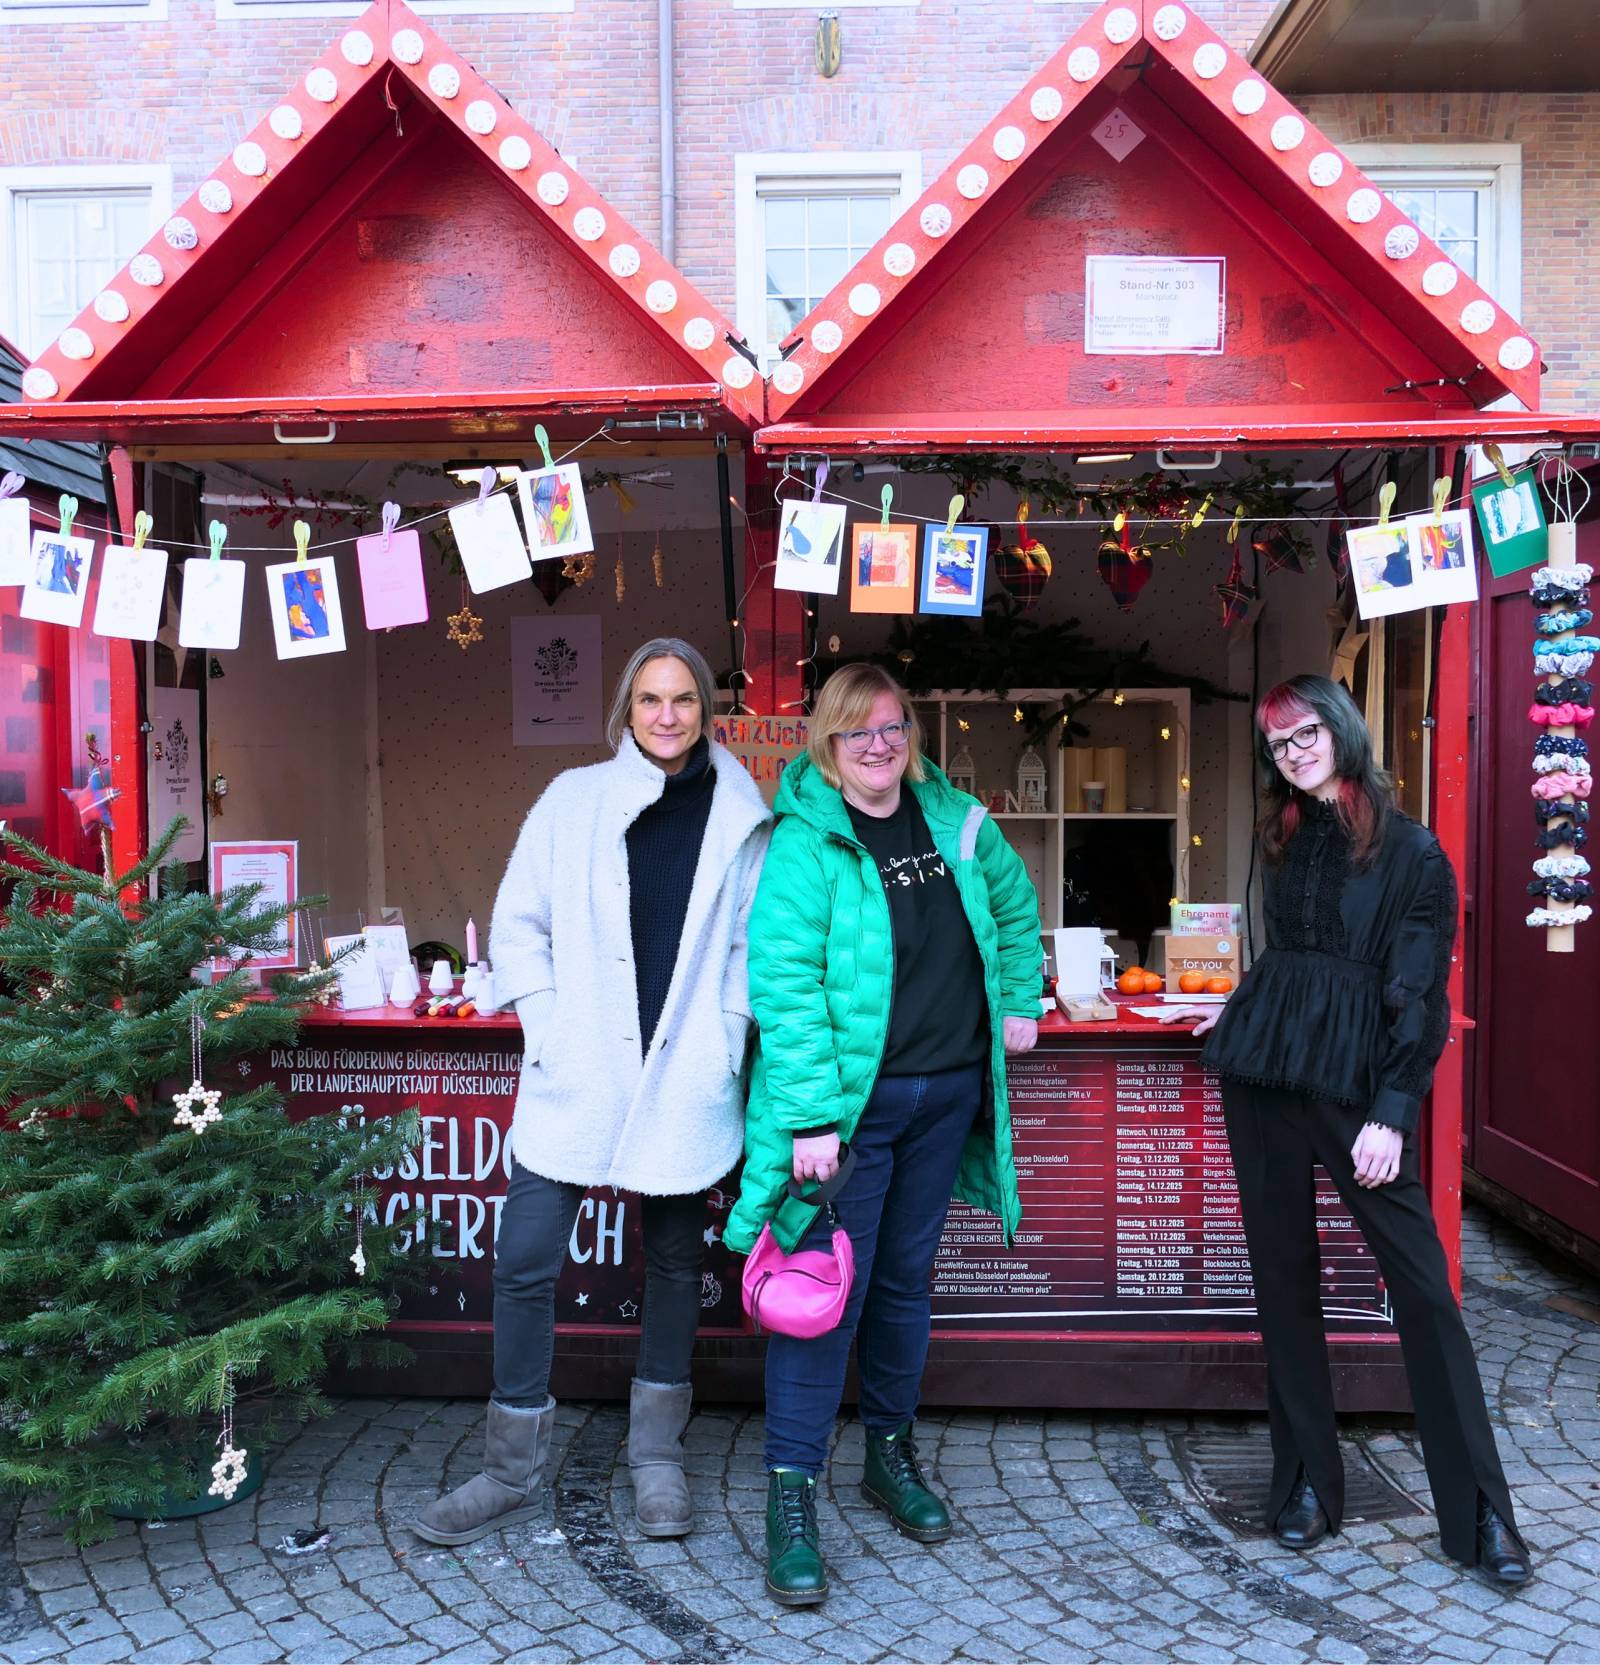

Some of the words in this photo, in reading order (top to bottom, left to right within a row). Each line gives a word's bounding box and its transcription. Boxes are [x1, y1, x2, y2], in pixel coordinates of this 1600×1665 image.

[1104, 124, 1129, 139] 25
[1119, 280, 1172, 290] Stand-Nr.
[1175, 280, 1195, 290] 303
[1181, 909, 1230, 919] Ehrenamt
[1183, 959, 1198, 969] for
[1201, 960, 1222, 970] you
[271, 1049, 294, 1069] DAS
[297, 1047, 330, 1069] BÜRO
[333, 1048, 403, 1070] FÖRDERUNG
[1012, 1064, 1046, 1072] Düsseldorf
[1116, 1063, 1146, 1073] Samstag,
[1148, 1063, 1184, 1072] 06.12.2025
[291, 1073, 315, 1093] DER
[317, 1074, 439, 1095] LANDESHAUPTSTADT
[442, 1072, 516, 1095] DÜSSELDORF
[1033, 1077, 1068, 1087] Integration
[1116, 1077, 1145, 1086] Sonntag,
[1146, 1077, 1182, 1085] 07.12.2025
[1016, 1090, 1067, 1099] Menschenwürde
[1067, 1091, 1080, 1099] IPM
[1116, 1091, 1143, 1100] Montag,
[1143, 1091, 1180, 1099] 08.12.2025
[1116, 1104, 1147, 1113] Dienstag,
[1148, 1104, 1184, 1112] 09.12.2025
[1203, 1104, 1221, 1112] SKFM
[1012, 1117, 1046, 1126] Düsseldorf
[1203, 1115, 1224, 1123] Düssel
[1116, 1128, 1148, 1136] Mittwoch,
[1150, 1128, 1185, 1136] 10.12.2025
[1116, 1142, 1156, 1150] Donnerstag,
[1158, 1142, 1193, 1150] 11.12.2025
[1033, 1155, 1069, 1163] Düsseldorf)
[1116, 1155, 1142, 1164] Freitag,
[1144, 1155, 1180, 1163] 12.12.2025
[1203, 1155, 1224, 1164] Hospiz
[1116, 1168, 1146, 1177] Samstag,
[1148, 1168, 1184, 1176] 13.12.2025
[1116, 1182, 1145, 1190] Sonntag,
[1147, 1182, 1182, 1190] 14.12.2025
[1116, 1195, 1143, 1204] Montag,
[1145, 1195, 1180, 1203] 15.12.2025
[971, 1208, 986, 1216] NRW
[1203, 1206, 1237, 1214] Düsseldorf
[962, 1221, 996, 1230] Düsseldorf
[1116, 1219, 1147, 1228] Dienstag,
[1149, 1219, 1184, 1227] 16.12.2025
[1203, 1219, 1237, 1228] grenzenlos
[1316, 1220, 1329, 1228] den
[1329, 1220, 1352, 1228] Verlust
[953, 1234, 975, 1243] GEGEN
[976, 1234, 1001, 1243] RECHTS
[1116, 1233, 1148, 1241] Mittwoch,
[1150, 1233, 1185, 1241] 17.12.2025
[1203, 1233, 1246, 1241] Verkehrswach
[935, 1248, 951, 1256] LAN
[1116, 1246, 1156, 1254] Donnerstag,
[1158, 1246, 1193, 1254] 18.12.2025
[1203, 1246, 1232, 1254] Leo-Club
[1232, 1246, 1249, 1255] Düss
[934, 1261, 979, 1270] EineWeltForum
[993, 1262, 999, 1270] &
[1000, 1261, 1028, 1270] Initiative
[1116, 1260, 1142, 1268] Freitag,
[1144, 1260, 1180, 1268] 19.12.2025
[1203, 1260, 1240, 1268] Blockblocks
[975, 1271, 1009, 1280] Düsseldorf
[1116, 1273, 1147, 1282] Samstag,
[1148, 1273, 1184, 1281] 20.12.2025
[1203, 1273, 1237, 1281] Düsseldorf
[934, 1285, 949, 1293] AWO
[949, 1285, 958, 1293] KV
[959, 1285, 993, 1294] Düsseldorf
[1116, 1286, 1145, 1295] Sonntag,
[1147, 1286, 1183, 1294] 21.12.2025
[1203, 1286, 1249, 1295] Elternnetzwerk
